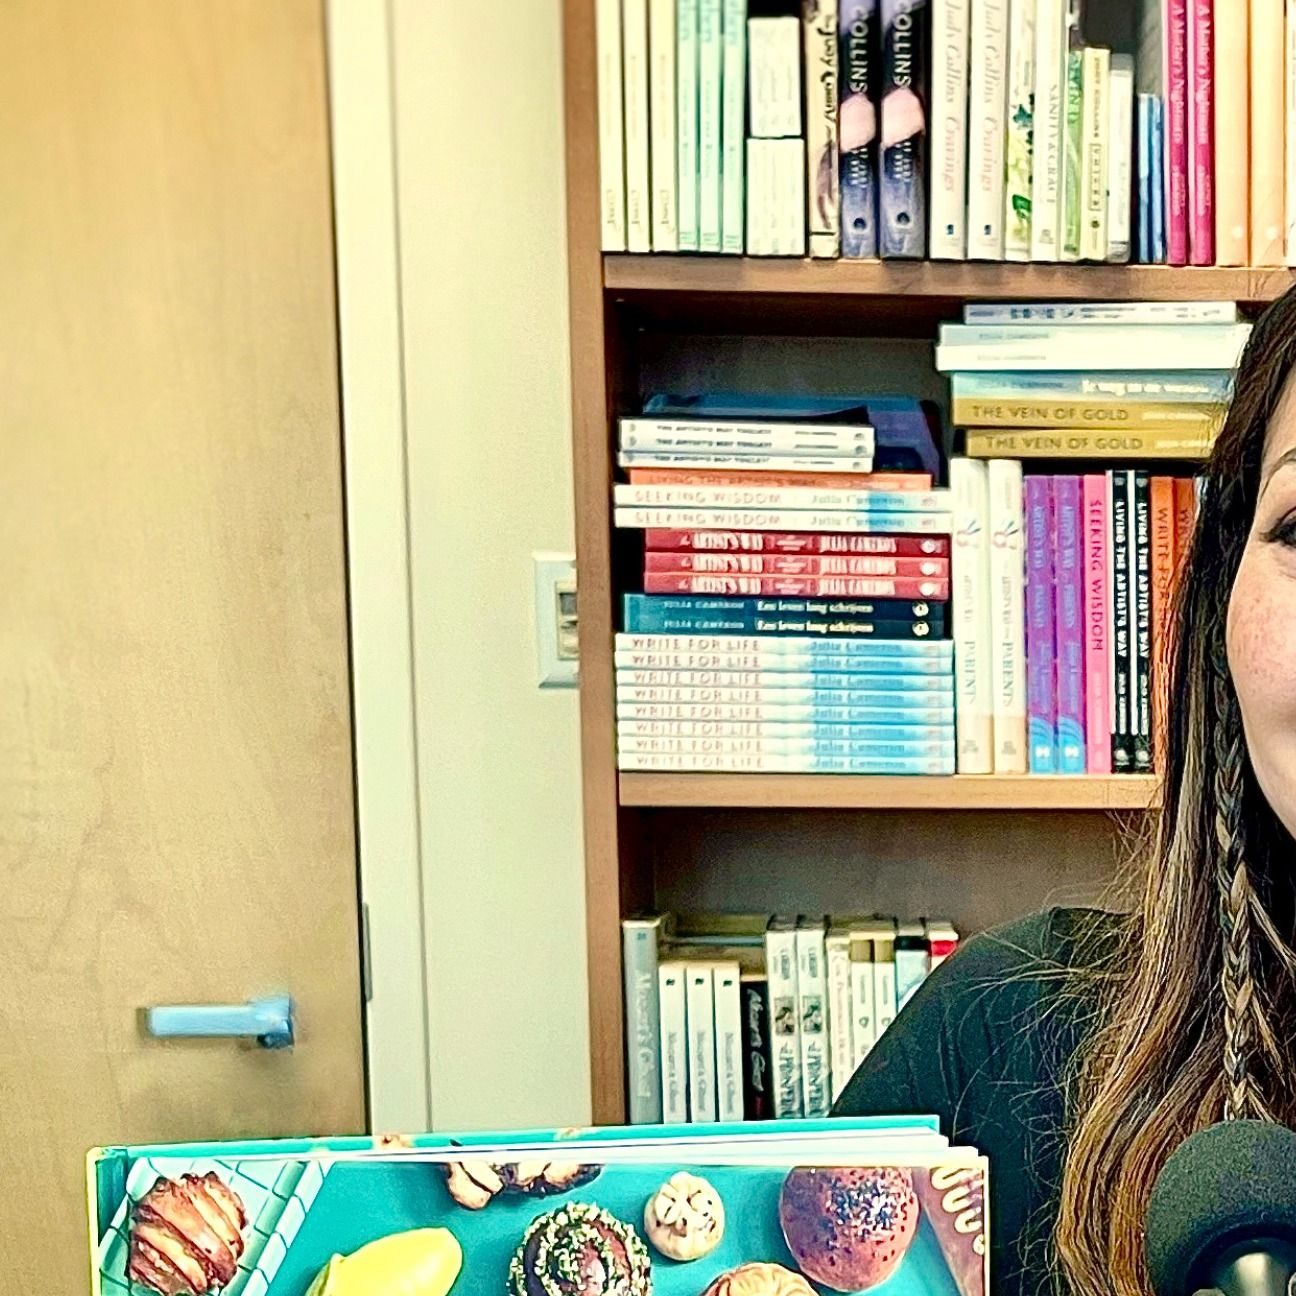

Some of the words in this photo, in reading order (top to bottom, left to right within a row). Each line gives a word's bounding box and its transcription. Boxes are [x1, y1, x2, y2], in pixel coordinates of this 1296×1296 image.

[972, 406, 1003, 418] THE
[1010, 407, 1047, 419] VEIN
[1055, 408, 1077, 420] OF
[1083, 409, 1129, 421] GOLD
[986, 436, 1016, 448] THE
[1024, 436, 1062, 449] VEIN
[1068, 437, 1088, 449] OF
[1097, 437, 1143, 450] GOLD
[713, 492, 781, 505] WISDOM
[1115, 501, 1125, 543] LIVING
[1090, 499, 1103, 571] SEEKING
[1116, 546, 1126, 569] THE
[1090, 579, 1103, 651] WISDOM
[632, 639, 681, 650] WRITE
[688, 639, 720, 651] FOR
[727, 640, 759, 651] LIFE
[1117, 631, 1127, 657] WAY
[1139, 632, 1149, 658] WAY
[633, 656, 681, 667] WRITE
[688, 656, 721, 667] FOR
[728, 657, 759, 668] LIFE
[634, 690, 682, 701] WRITE
[690, 690, 721, 702] FOR
[728, 690, 761, 702] LIFE
